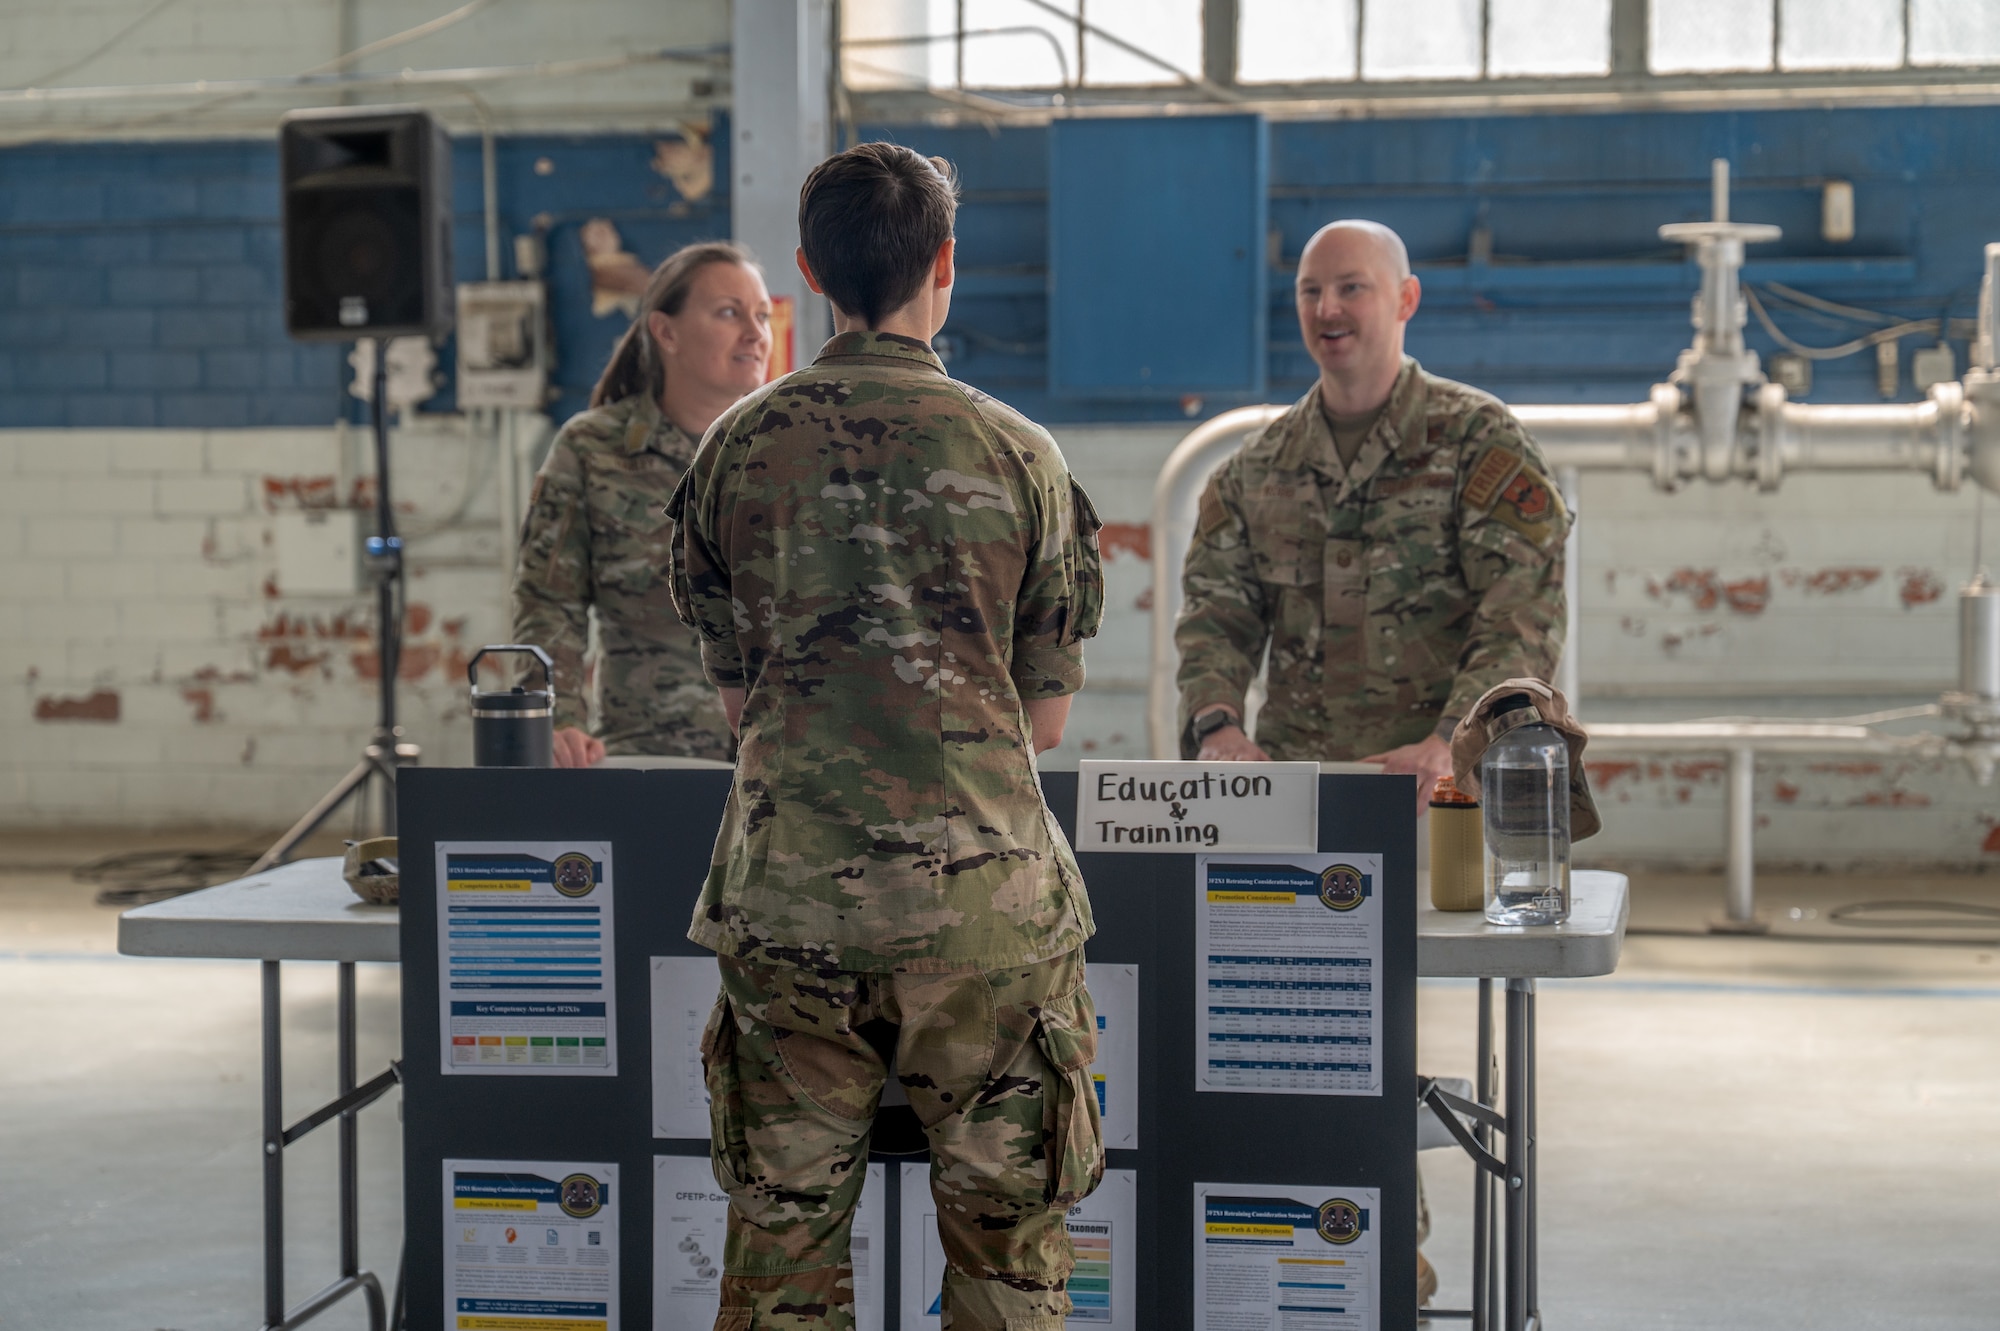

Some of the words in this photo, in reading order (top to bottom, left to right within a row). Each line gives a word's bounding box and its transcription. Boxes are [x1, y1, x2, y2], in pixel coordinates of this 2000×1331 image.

[1464, 450, 1513, 500] TRNG
[1097, 771, 1272, 802] Education
[1169, 802, 1188, 821] &
[1095, 821, 1219, 847] Training
[464, 867, 491, 875] Retraining
[1247, 894, 1290, 902] Considerations
[1534, 899, 1559, 909] YETI
[475, 1005, 489, 1014] Key
[489, 1005, 527, 1014] Competency
[471, 1186, 497, 1194] Retraining
[675, 1192, 708, 1201] CFETP:
[1224, 1210, 1251, 1218] Retraining
[1251, 1211, 1287, 1219] Consideration
[1288, 1212, 1312, 1220] Snapshot
[1065, 1223, 1109, 1235] Taxonomy
[1253, 1228, 1291, 1236] Deployments
